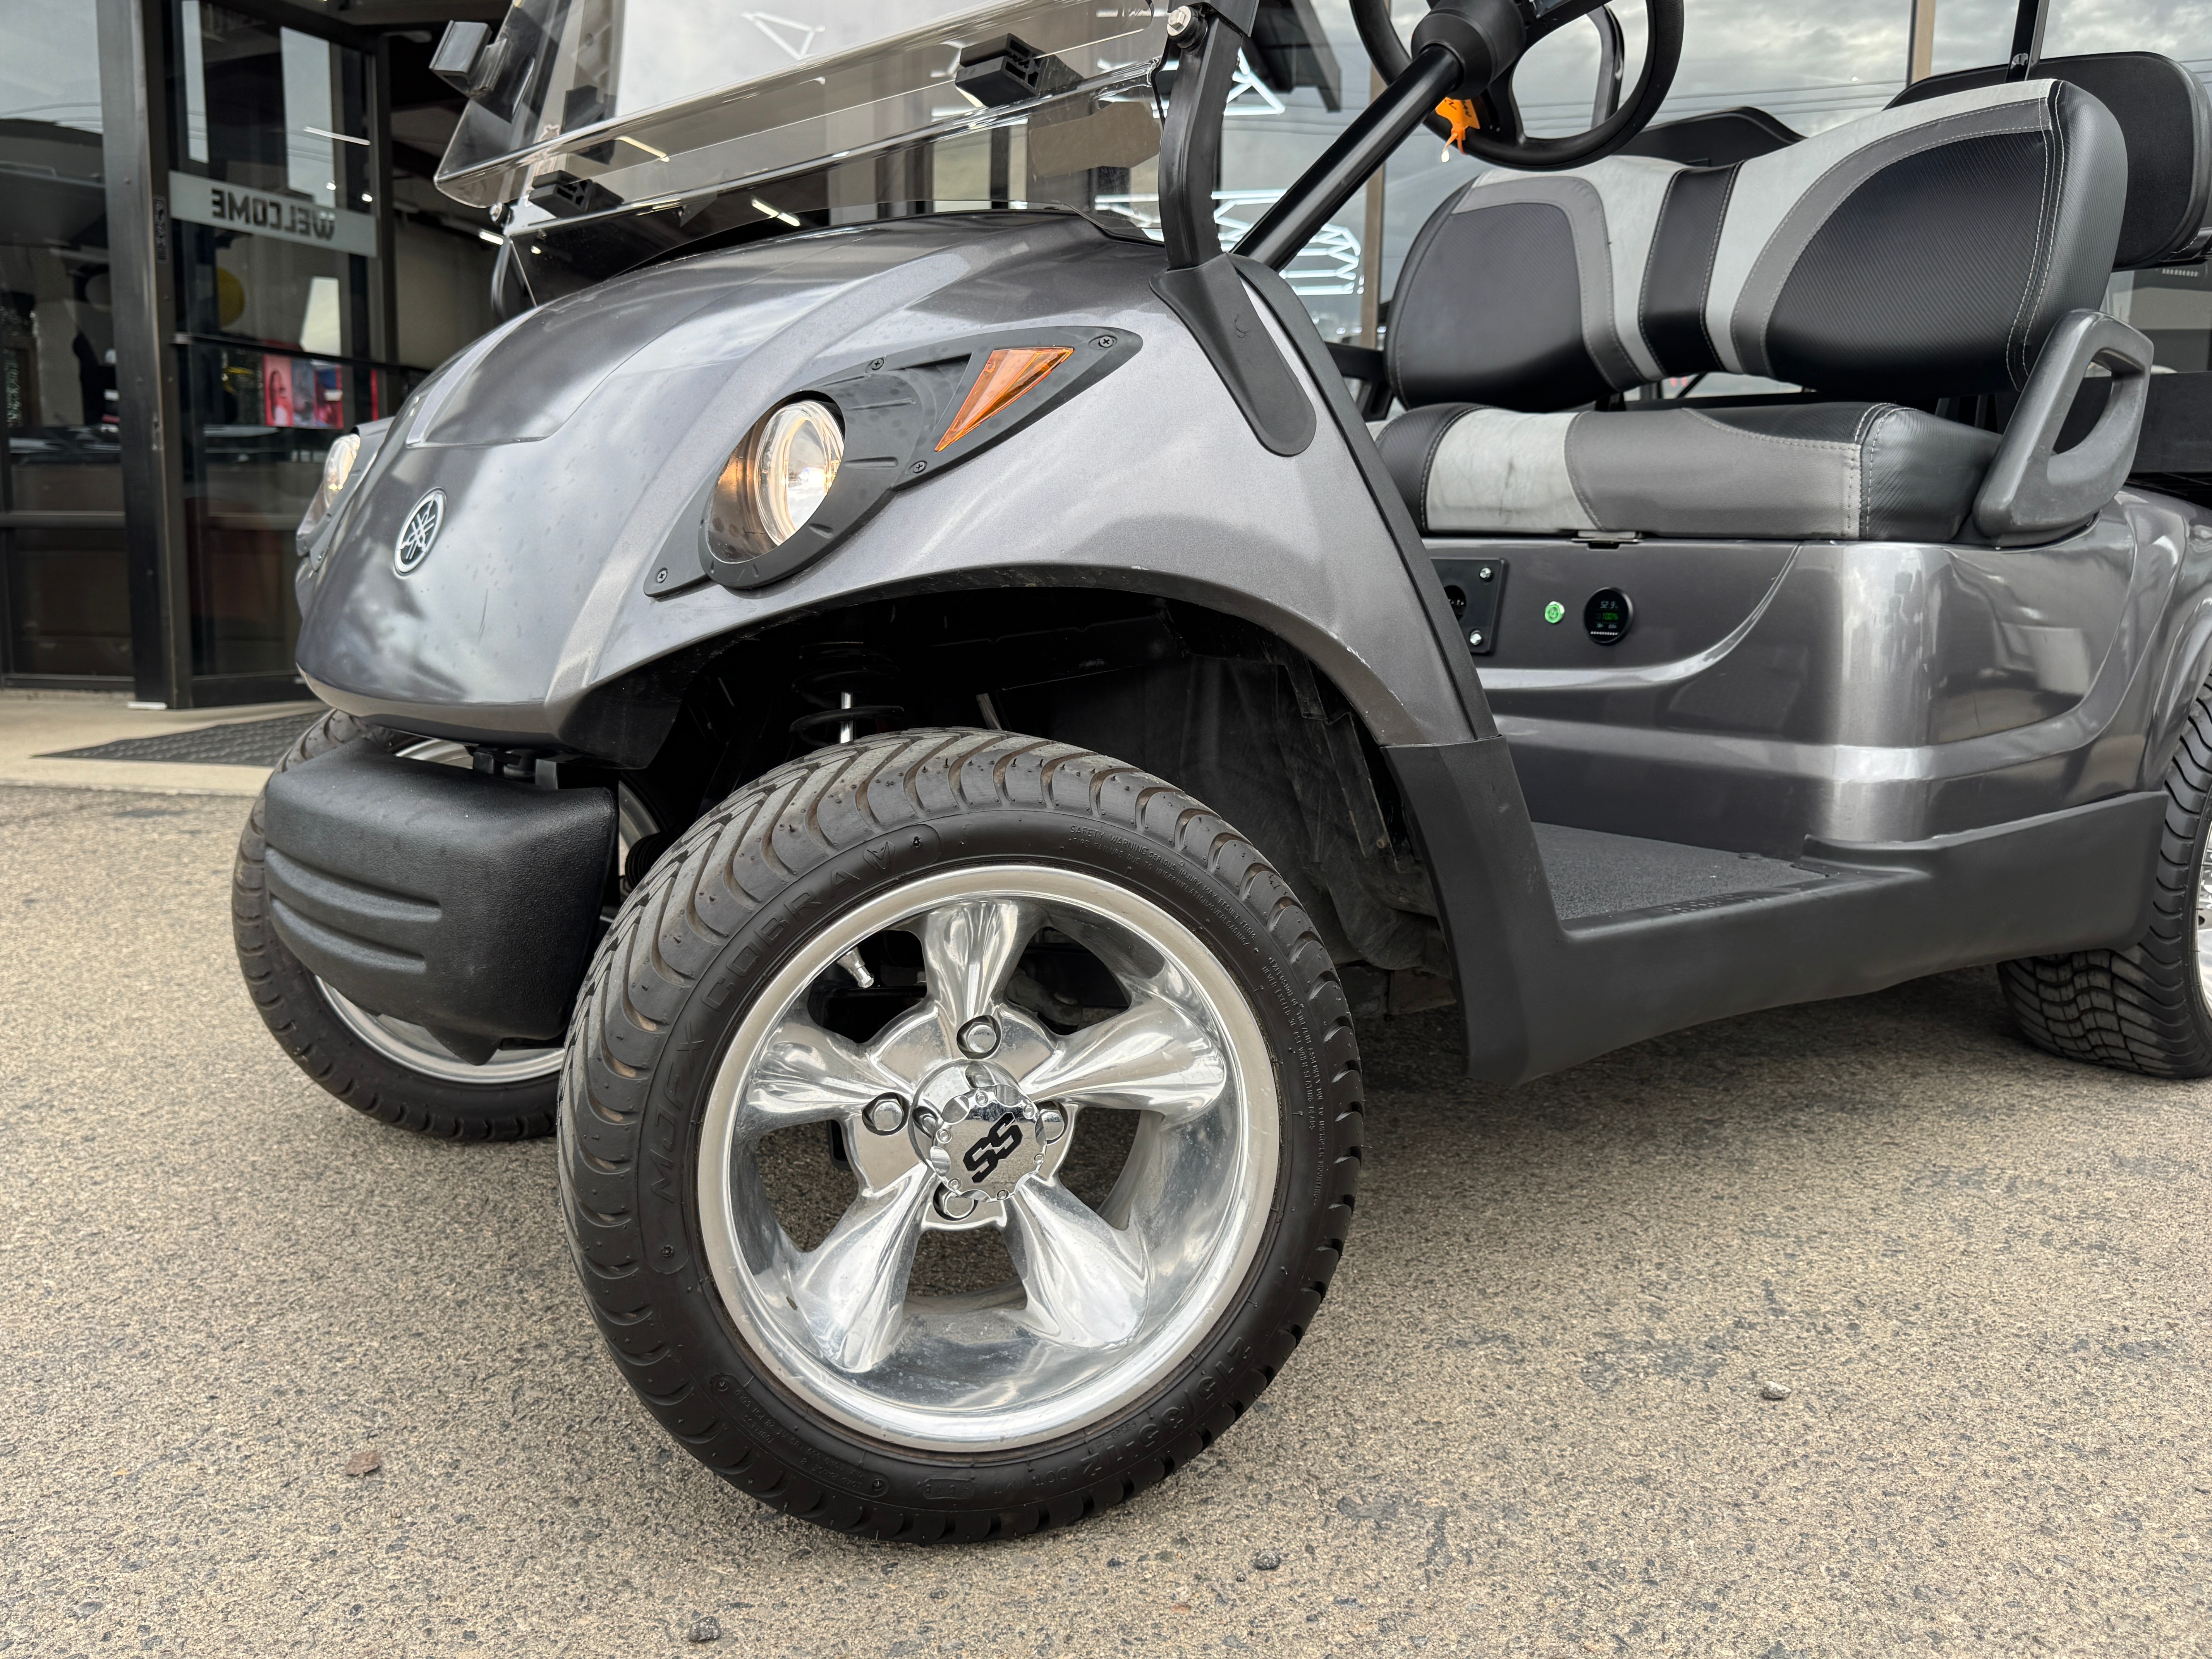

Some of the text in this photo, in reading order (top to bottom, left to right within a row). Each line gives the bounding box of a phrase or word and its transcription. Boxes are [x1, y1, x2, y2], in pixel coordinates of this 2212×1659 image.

[1069, 824, 1105, 840] SAFETY
[1147, 851, 1177, 871] SERIOUS
[1178, 867, 1202, 888] INJURY
[1201, 884, 1218, 900] MAY
[1217, 898, 1241, 922] RESULT
[701, 867, 860, 1012] COBRA
